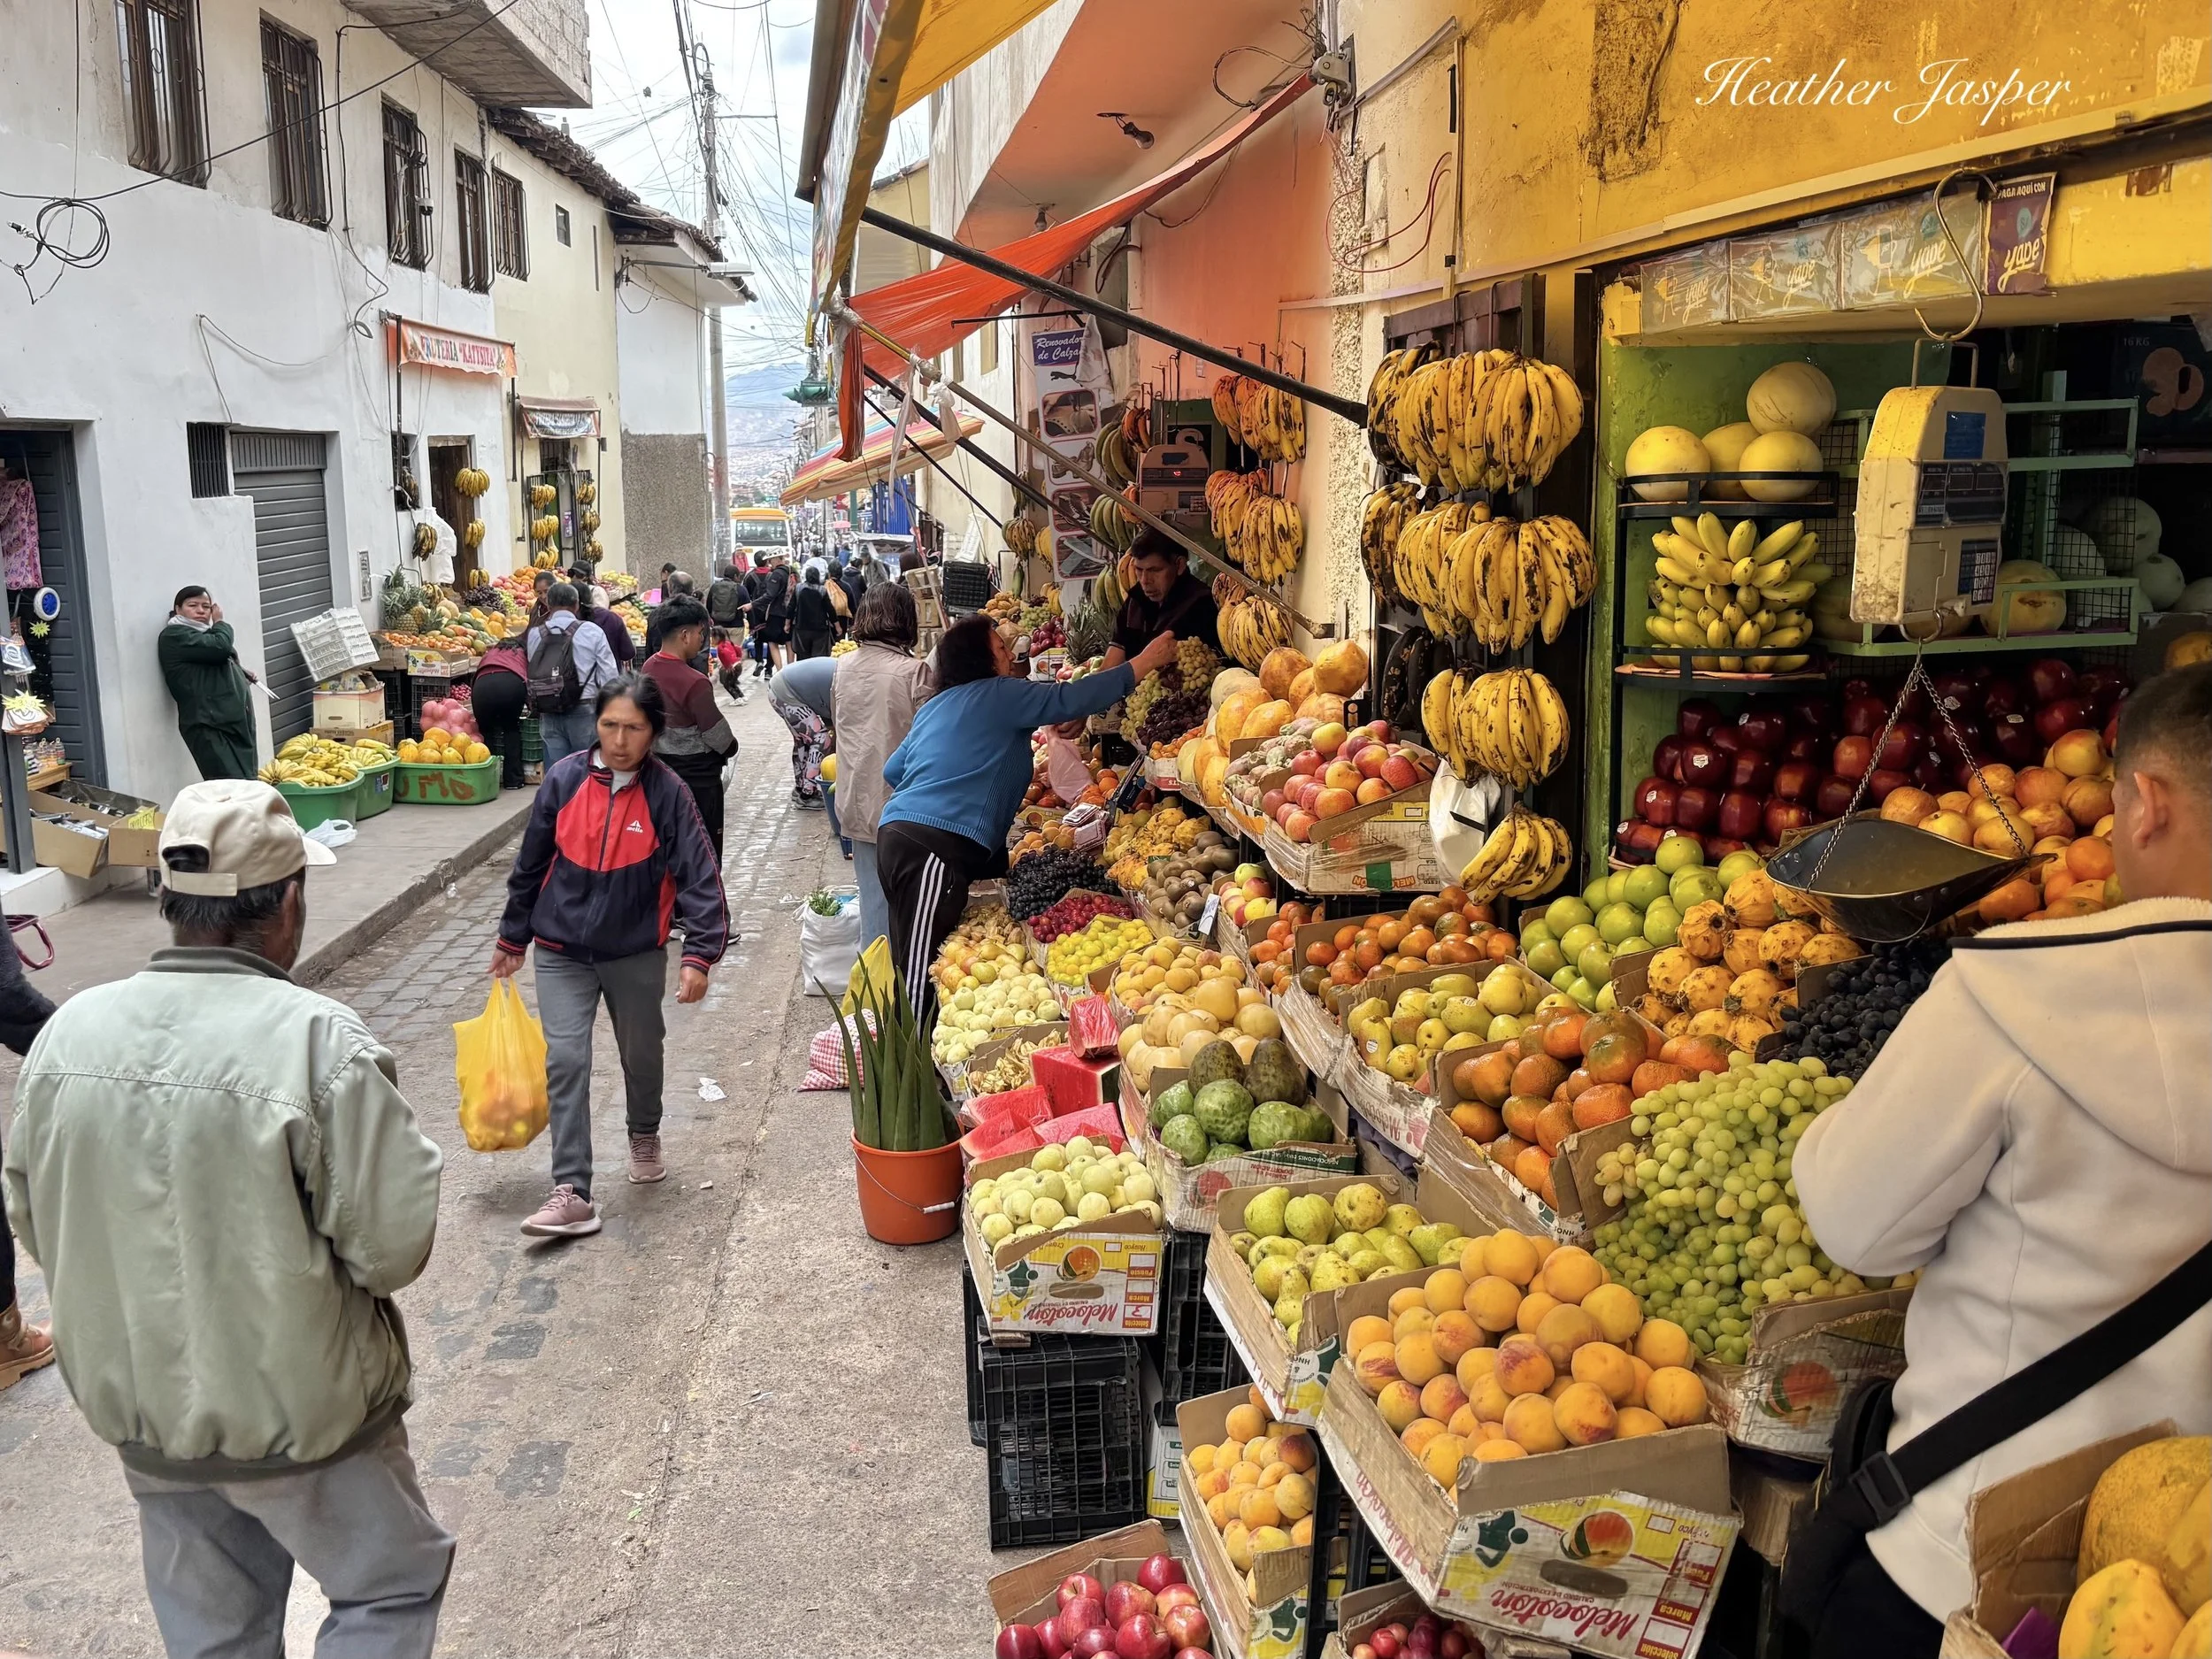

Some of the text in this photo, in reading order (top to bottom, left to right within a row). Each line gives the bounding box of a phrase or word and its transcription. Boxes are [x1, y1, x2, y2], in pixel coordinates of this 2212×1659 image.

[2033, 181, 2046, 193] CON
[1903, 239, 1947, 299] yape
[1998, 238, 2040, 293] yape
[1783, 259, 1815, 310] yape
[1683, 276, 1709, 325] yape
[1034, 334, 1083, 349] Renovado
[1038, 346, 1080, 361] de Calza
[1352, 875, 1416, 889] MELÓN
[1028, 1302, 1118, 1326] Melocotón
[1491, 1589, 1640, 1640] Melocotón
[1659, 1604, 1693, 1622] Marca
